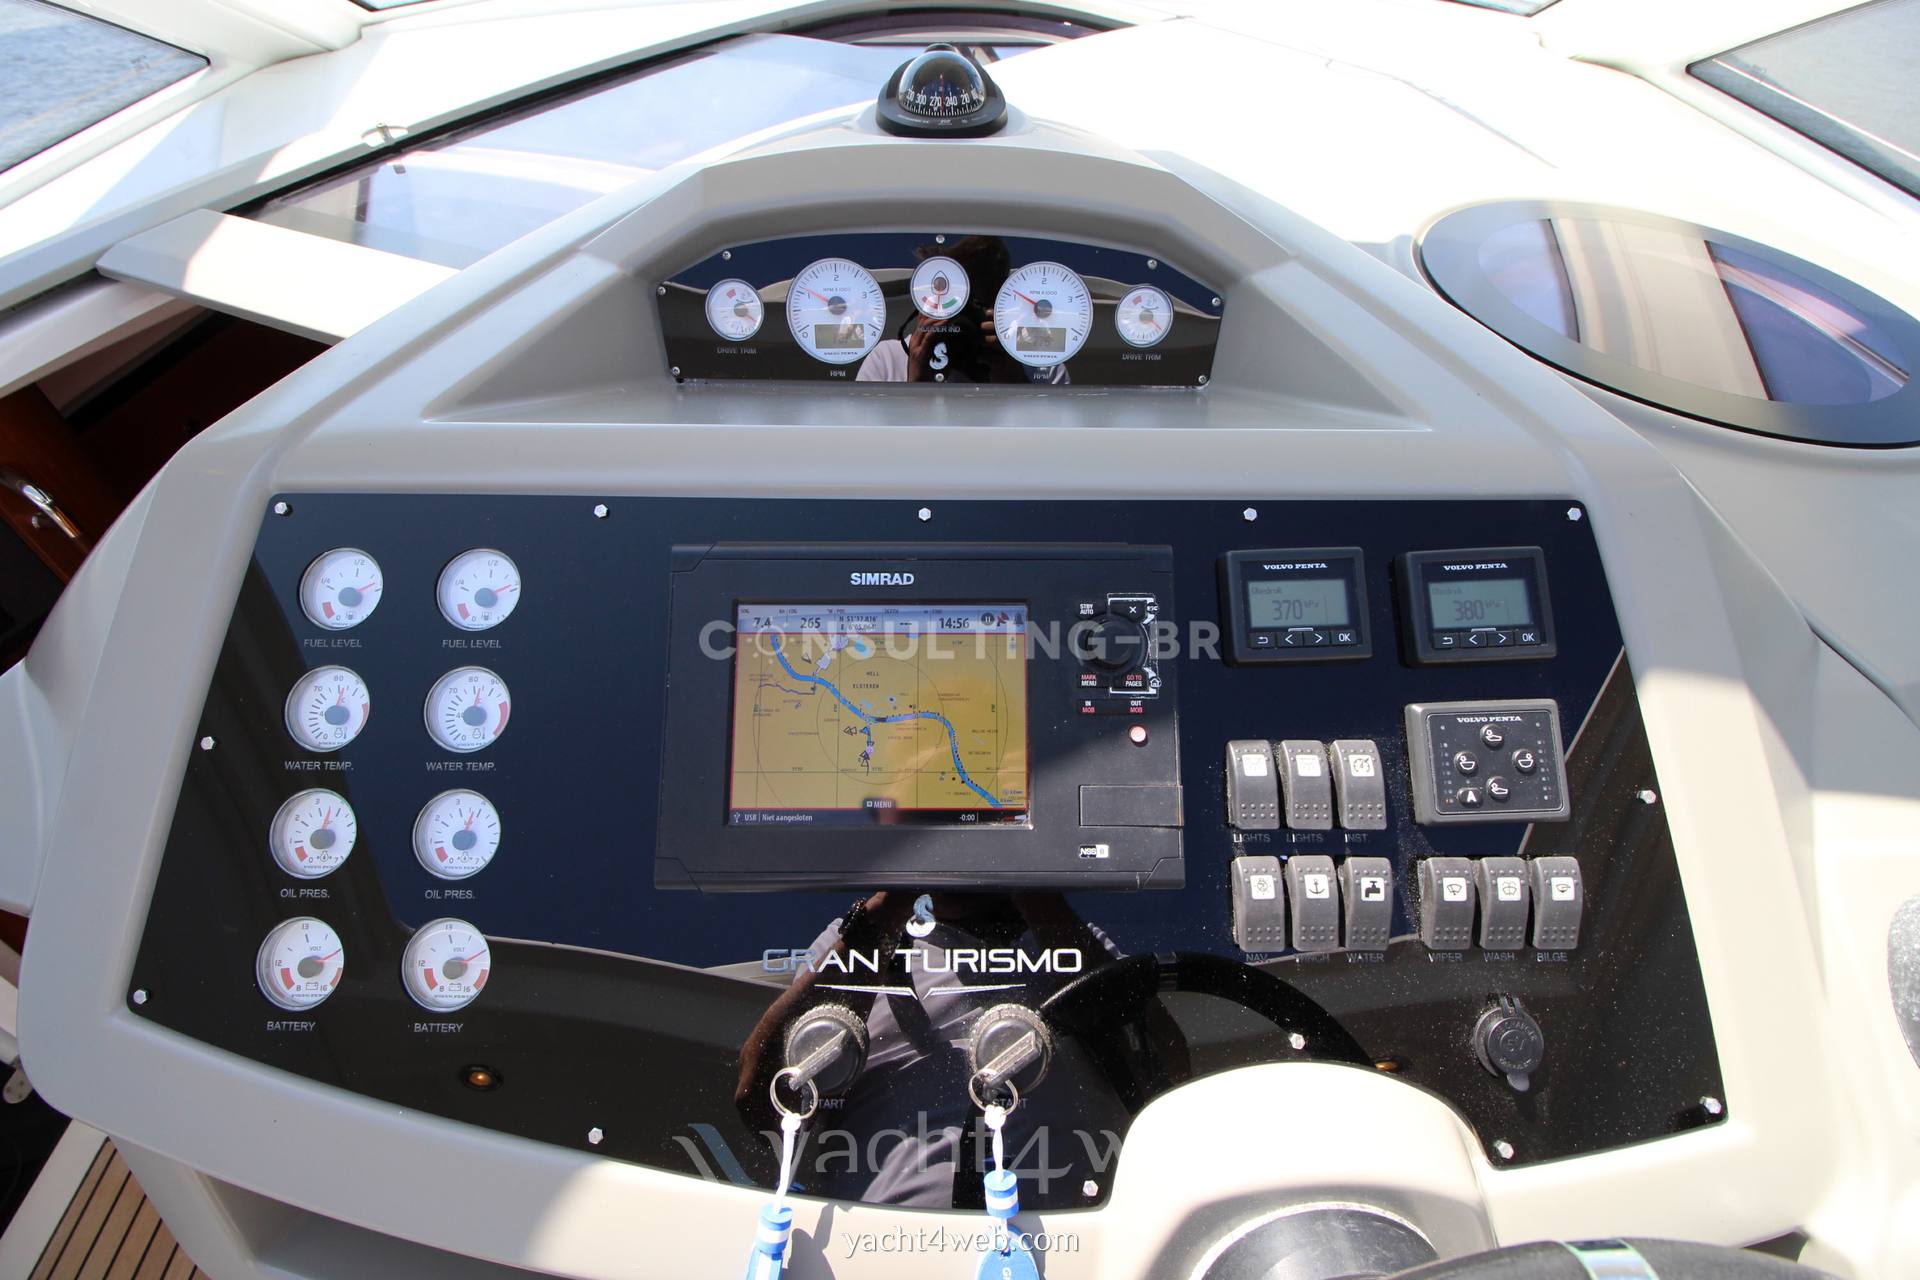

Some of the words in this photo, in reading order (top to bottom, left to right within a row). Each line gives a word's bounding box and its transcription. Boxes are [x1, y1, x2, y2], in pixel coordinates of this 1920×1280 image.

[946, 95, 958, 107] 240
[850, 572, 915, 586] SIMRAD
[1272, 599, 1303, 621] 370
[1453, 599, 1485, 621] 380
[754, 617, 772, 628] 7.4
[800, 617, 821, 629] 265
[939, 617, 970, 629] 14:56
[1338, 633, 1351, 642] OK
[1522, 633, 1535, 642] OK
[304, 639, 329, 648] FUEL
[331, 639, 362, 648] LEVEL
[443, 640, 468, 648] FUEL
[471, 640, 501, 648] LEVEL
[285, 761, 320, 770] WATER
[324, 761, 354, 770] TEMP.
[426, 762, 462, 771] WATER
[466, 762, 497, 771] TEMP.
[1467, 791, 1477, 802] A
[775, 814, 813, 823] aangesloten
[1233, 834, 1270, 843] LIGHTS
[1286, 834, 1323, 843] LIGHTS
[1080, 847, 1096, 855] NSS
[280, 888, 297, 898] OIL
[299, 888, 330, 898] PRES.
[424, 889, 442, 899] OIL
[444, 889, 475, 899] PRES.
[763, 949, 879, 973] GRAN
[896, 949, 1082, 973] TURISMO
[1296, 953, 1329, 963] WINCH
[1346, 953, 1384, 963] WATER
[1428, 953, 1462, 962] WIPER
[1537, 953, 1567, 962] BILGE
[267, 1021, 315, 1031] BATTERY
[413, 1023, 463, 1032] BATTERY
